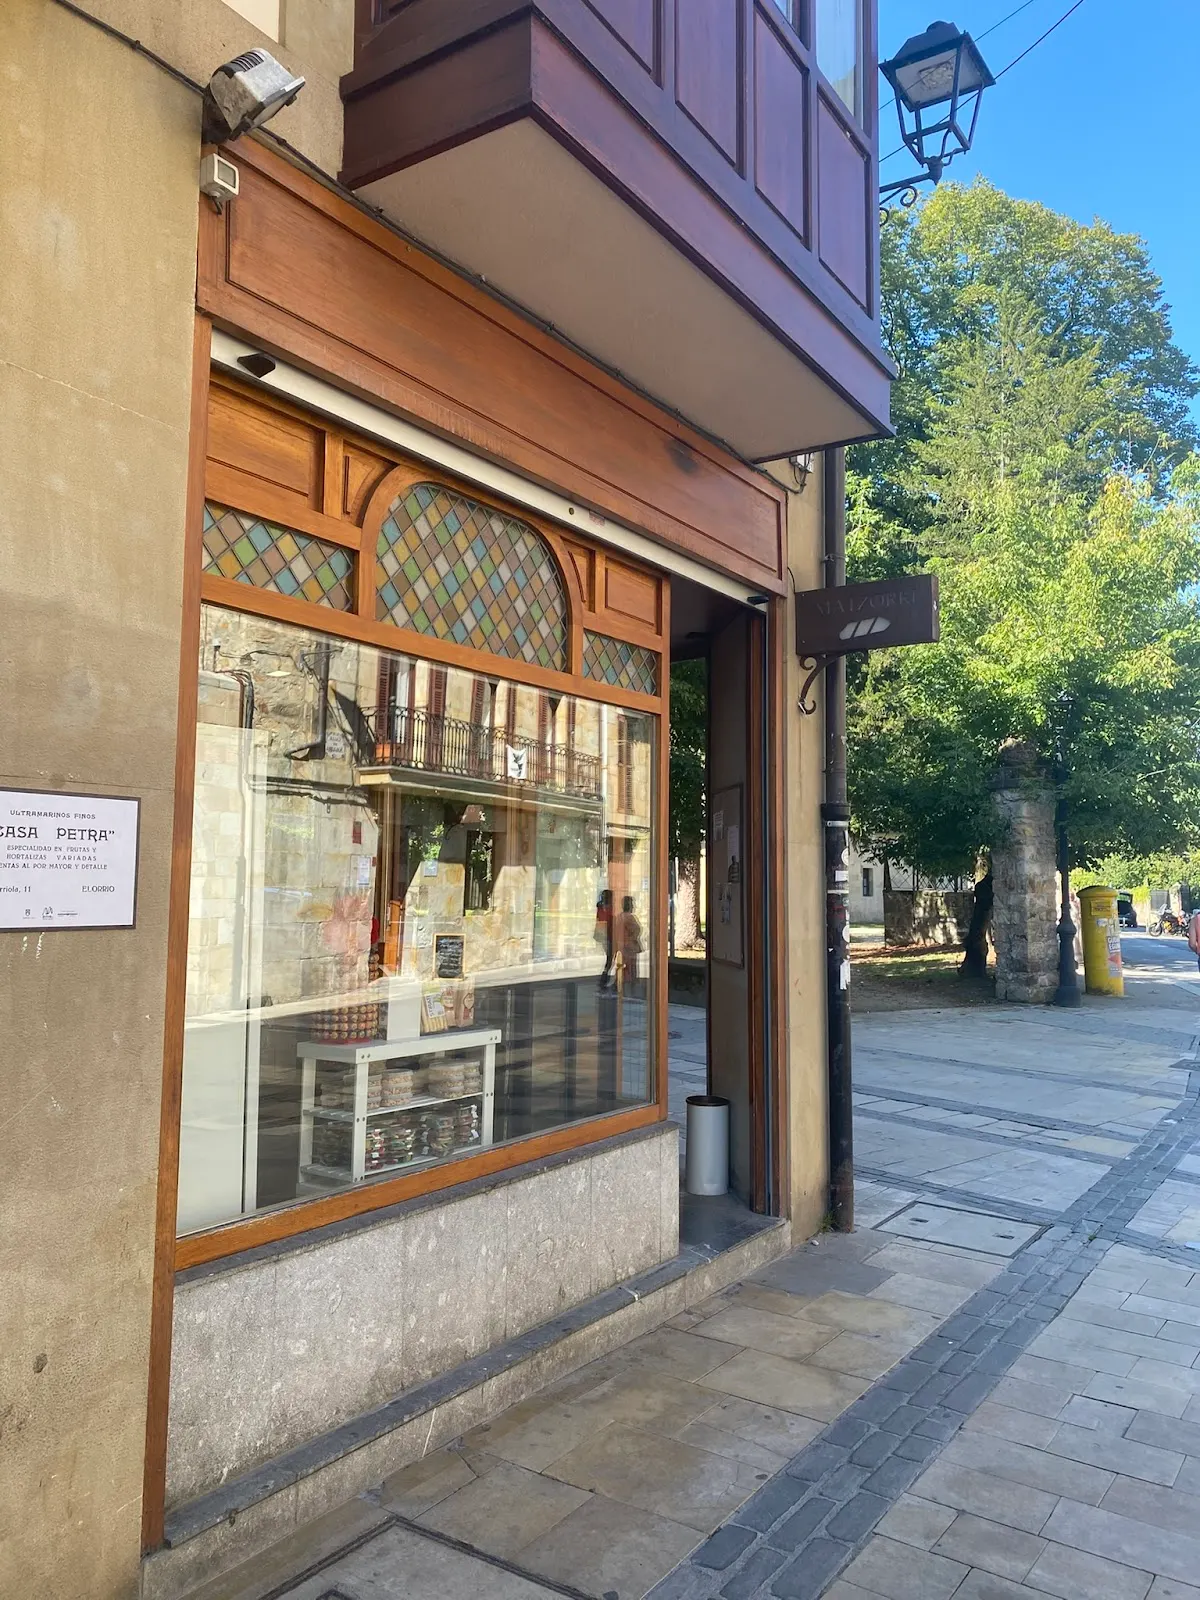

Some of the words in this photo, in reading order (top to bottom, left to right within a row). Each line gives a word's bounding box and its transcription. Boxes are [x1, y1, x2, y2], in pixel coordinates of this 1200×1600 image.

[10, 809, 71, 818] ULTRAMARINOS
[7, 844, 52, 852] ESPECIALIDAD
[82, 885, 115, 893] ELORRIO
